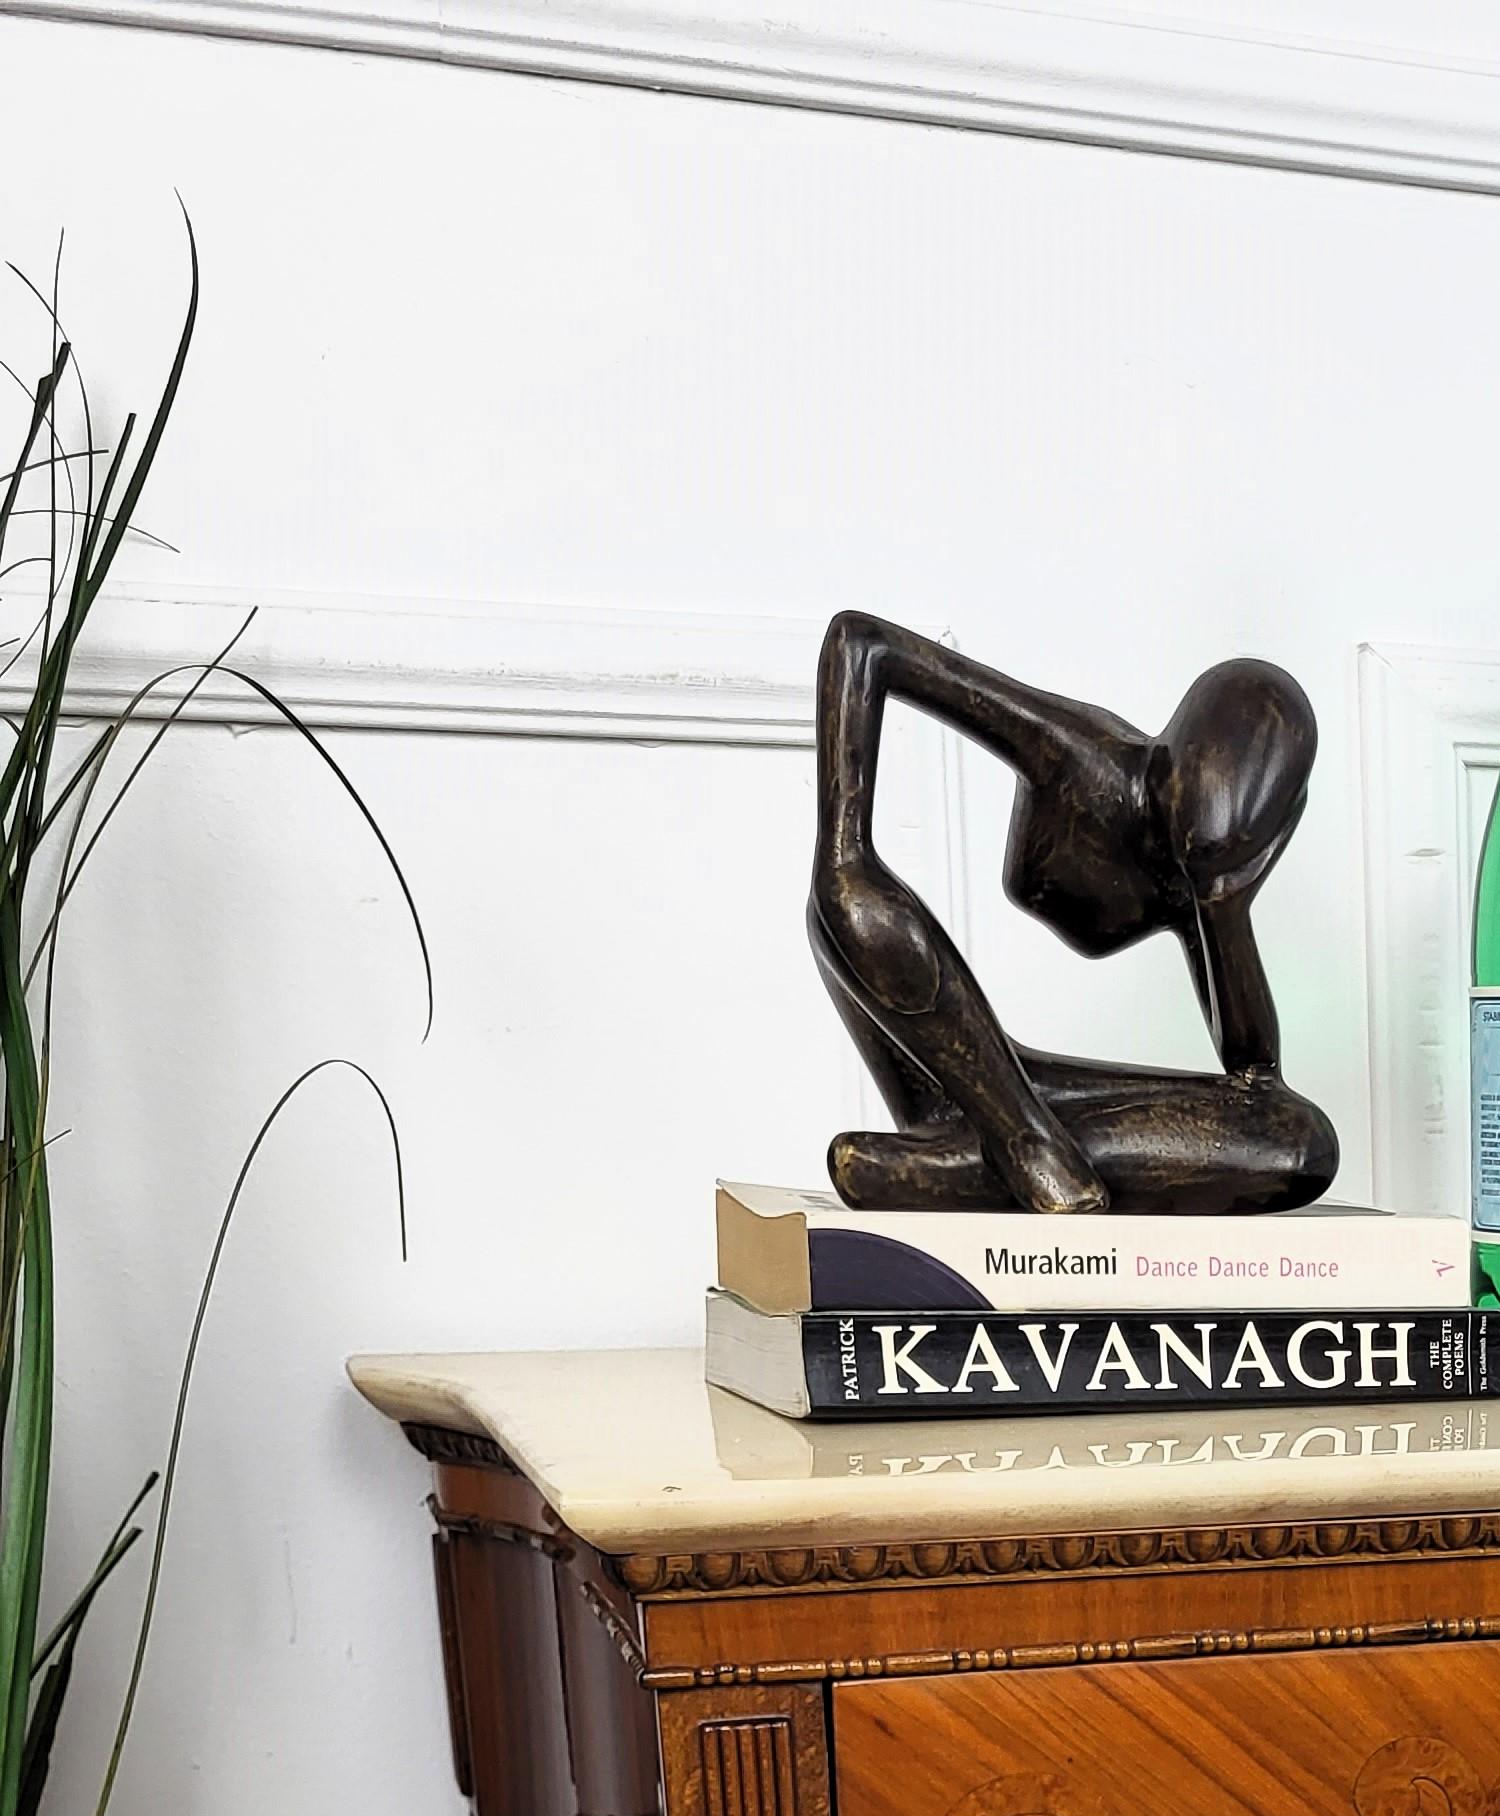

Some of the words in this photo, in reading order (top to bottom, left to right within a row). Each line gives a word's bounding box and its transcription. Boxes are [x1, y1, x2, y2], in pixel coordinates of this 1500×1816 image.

[985, 1247, 1118, 1276] Murakami
[1136, 1255, 1199, 1278] Dance
[1208, 1256, 1270, 1279] Dance
[1279, 1256, 1340, 1279] Dance
[839, 1317, 860, 1401] PATRICK
[871, 1320, 1419, 1396] KAVANAGH
[1429, 1340, 1440, 1368] THE
[1441, 1318, 1453, 1390] COMPLETE
[1454, 1331, 1465, 1376] POEMS
